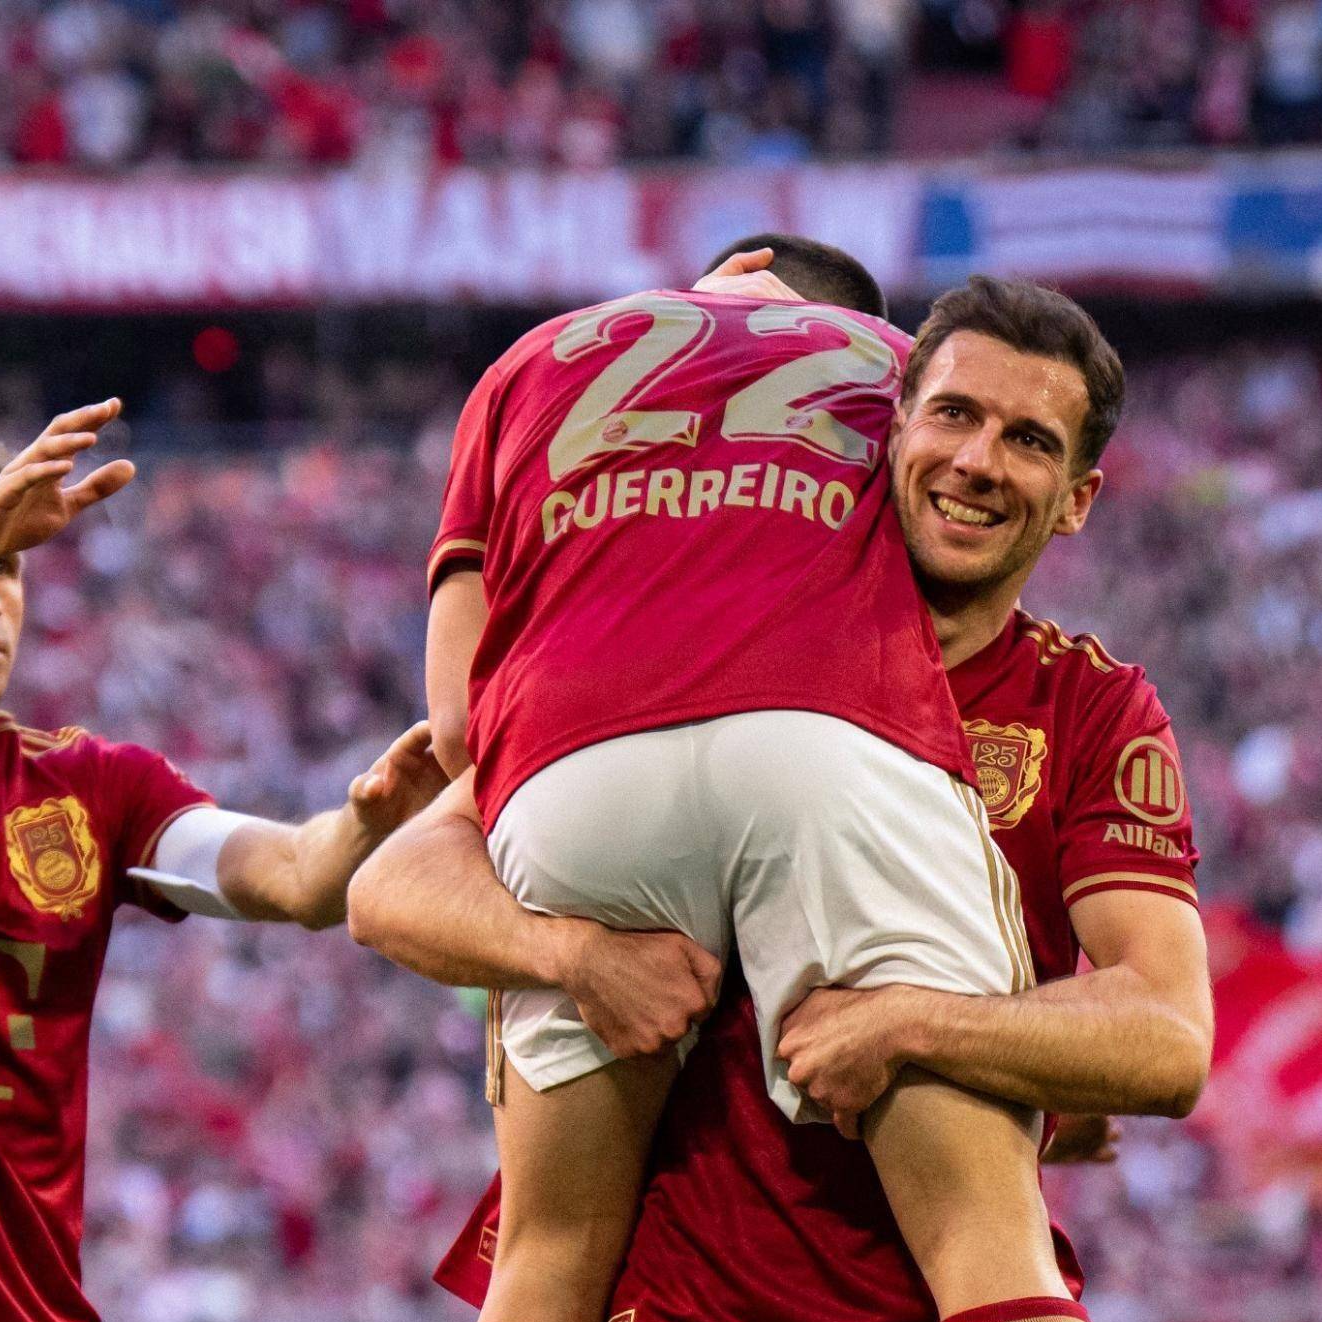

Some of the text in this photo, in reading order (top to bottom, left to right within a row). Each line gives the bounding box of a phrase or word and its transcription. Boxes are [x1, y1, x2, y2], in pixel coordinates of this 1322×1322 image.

[547, 290, 903, 483] 22
[540, 462, 857, 545] GUERREIRO
[1101, 822, 1184, 859] Allian
